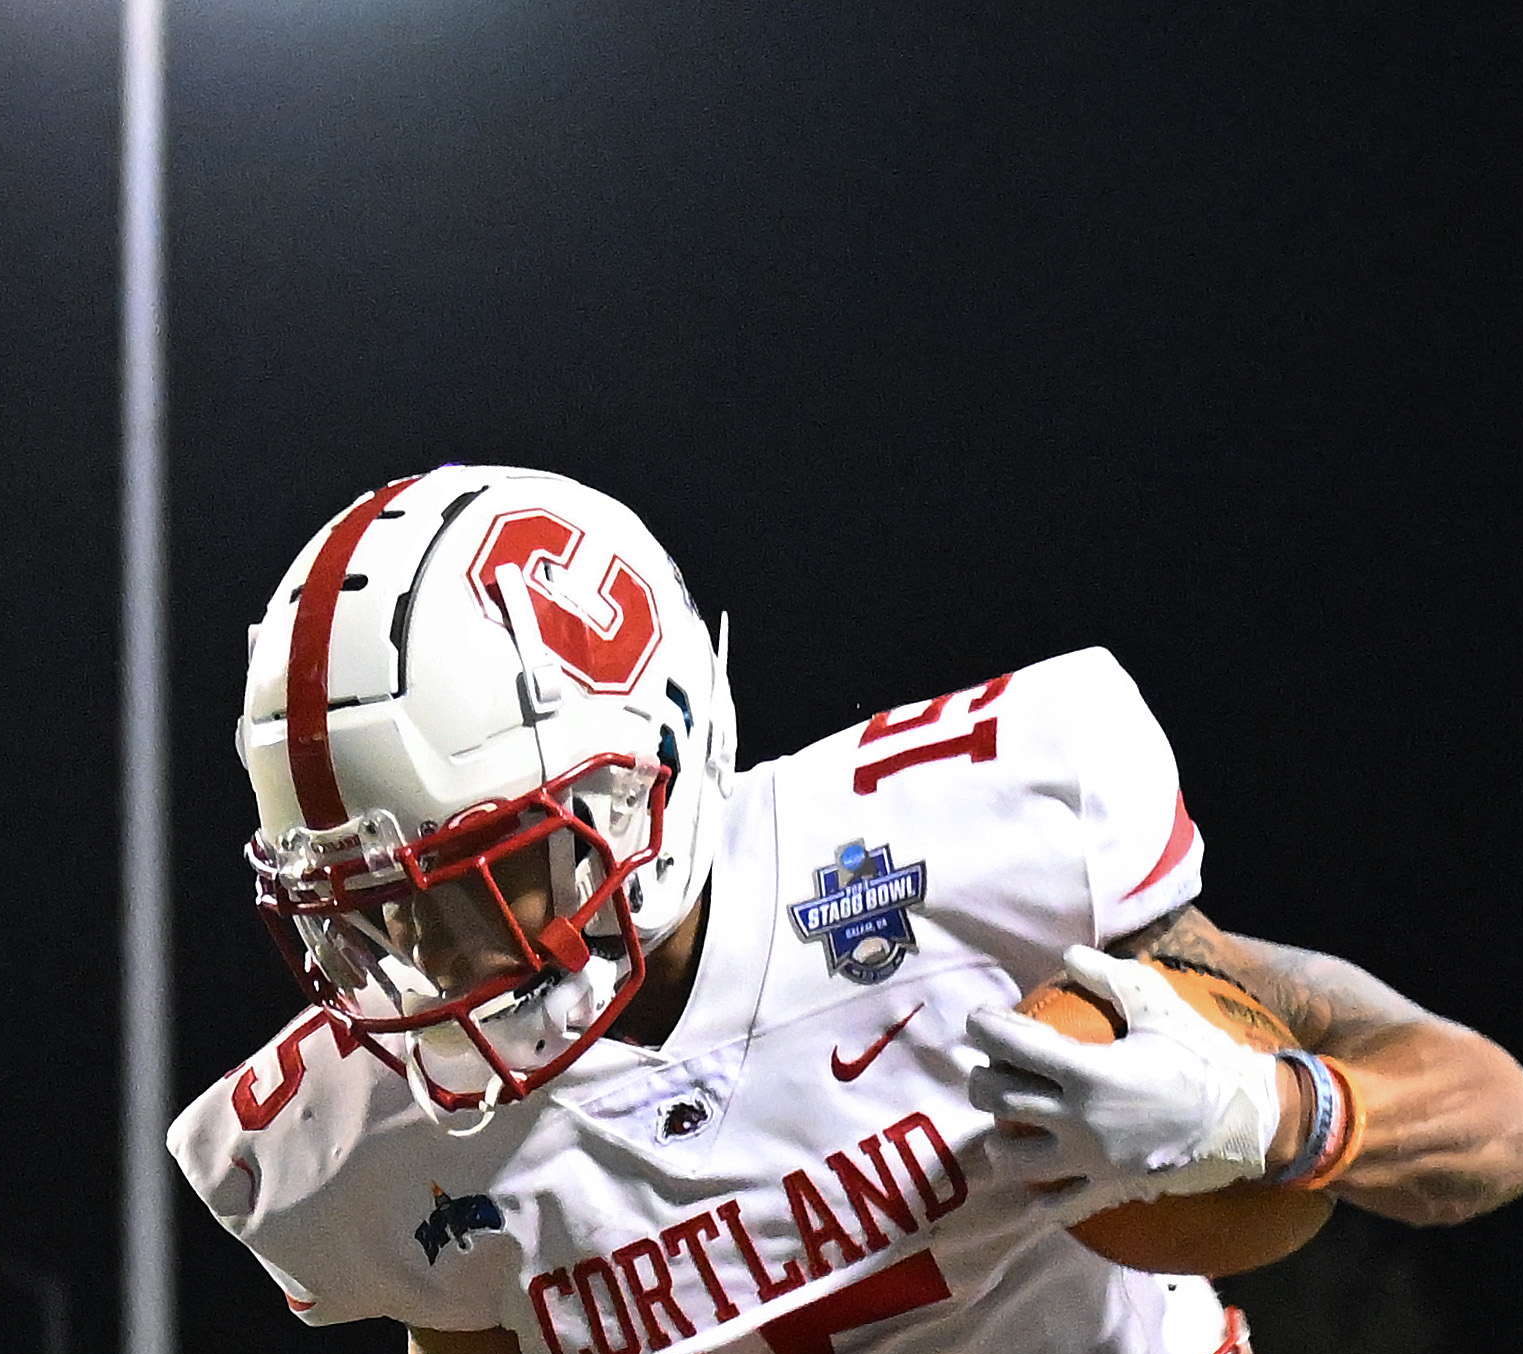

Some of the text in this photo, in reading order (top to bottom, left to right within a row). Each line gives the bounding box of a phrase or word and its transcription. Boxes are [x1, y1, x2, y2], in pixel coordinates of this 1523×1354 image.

[466, 508, 662, 695] C
[808, 893, 863, 930] STAGG
[866, 875, 916, 911] BOWL
